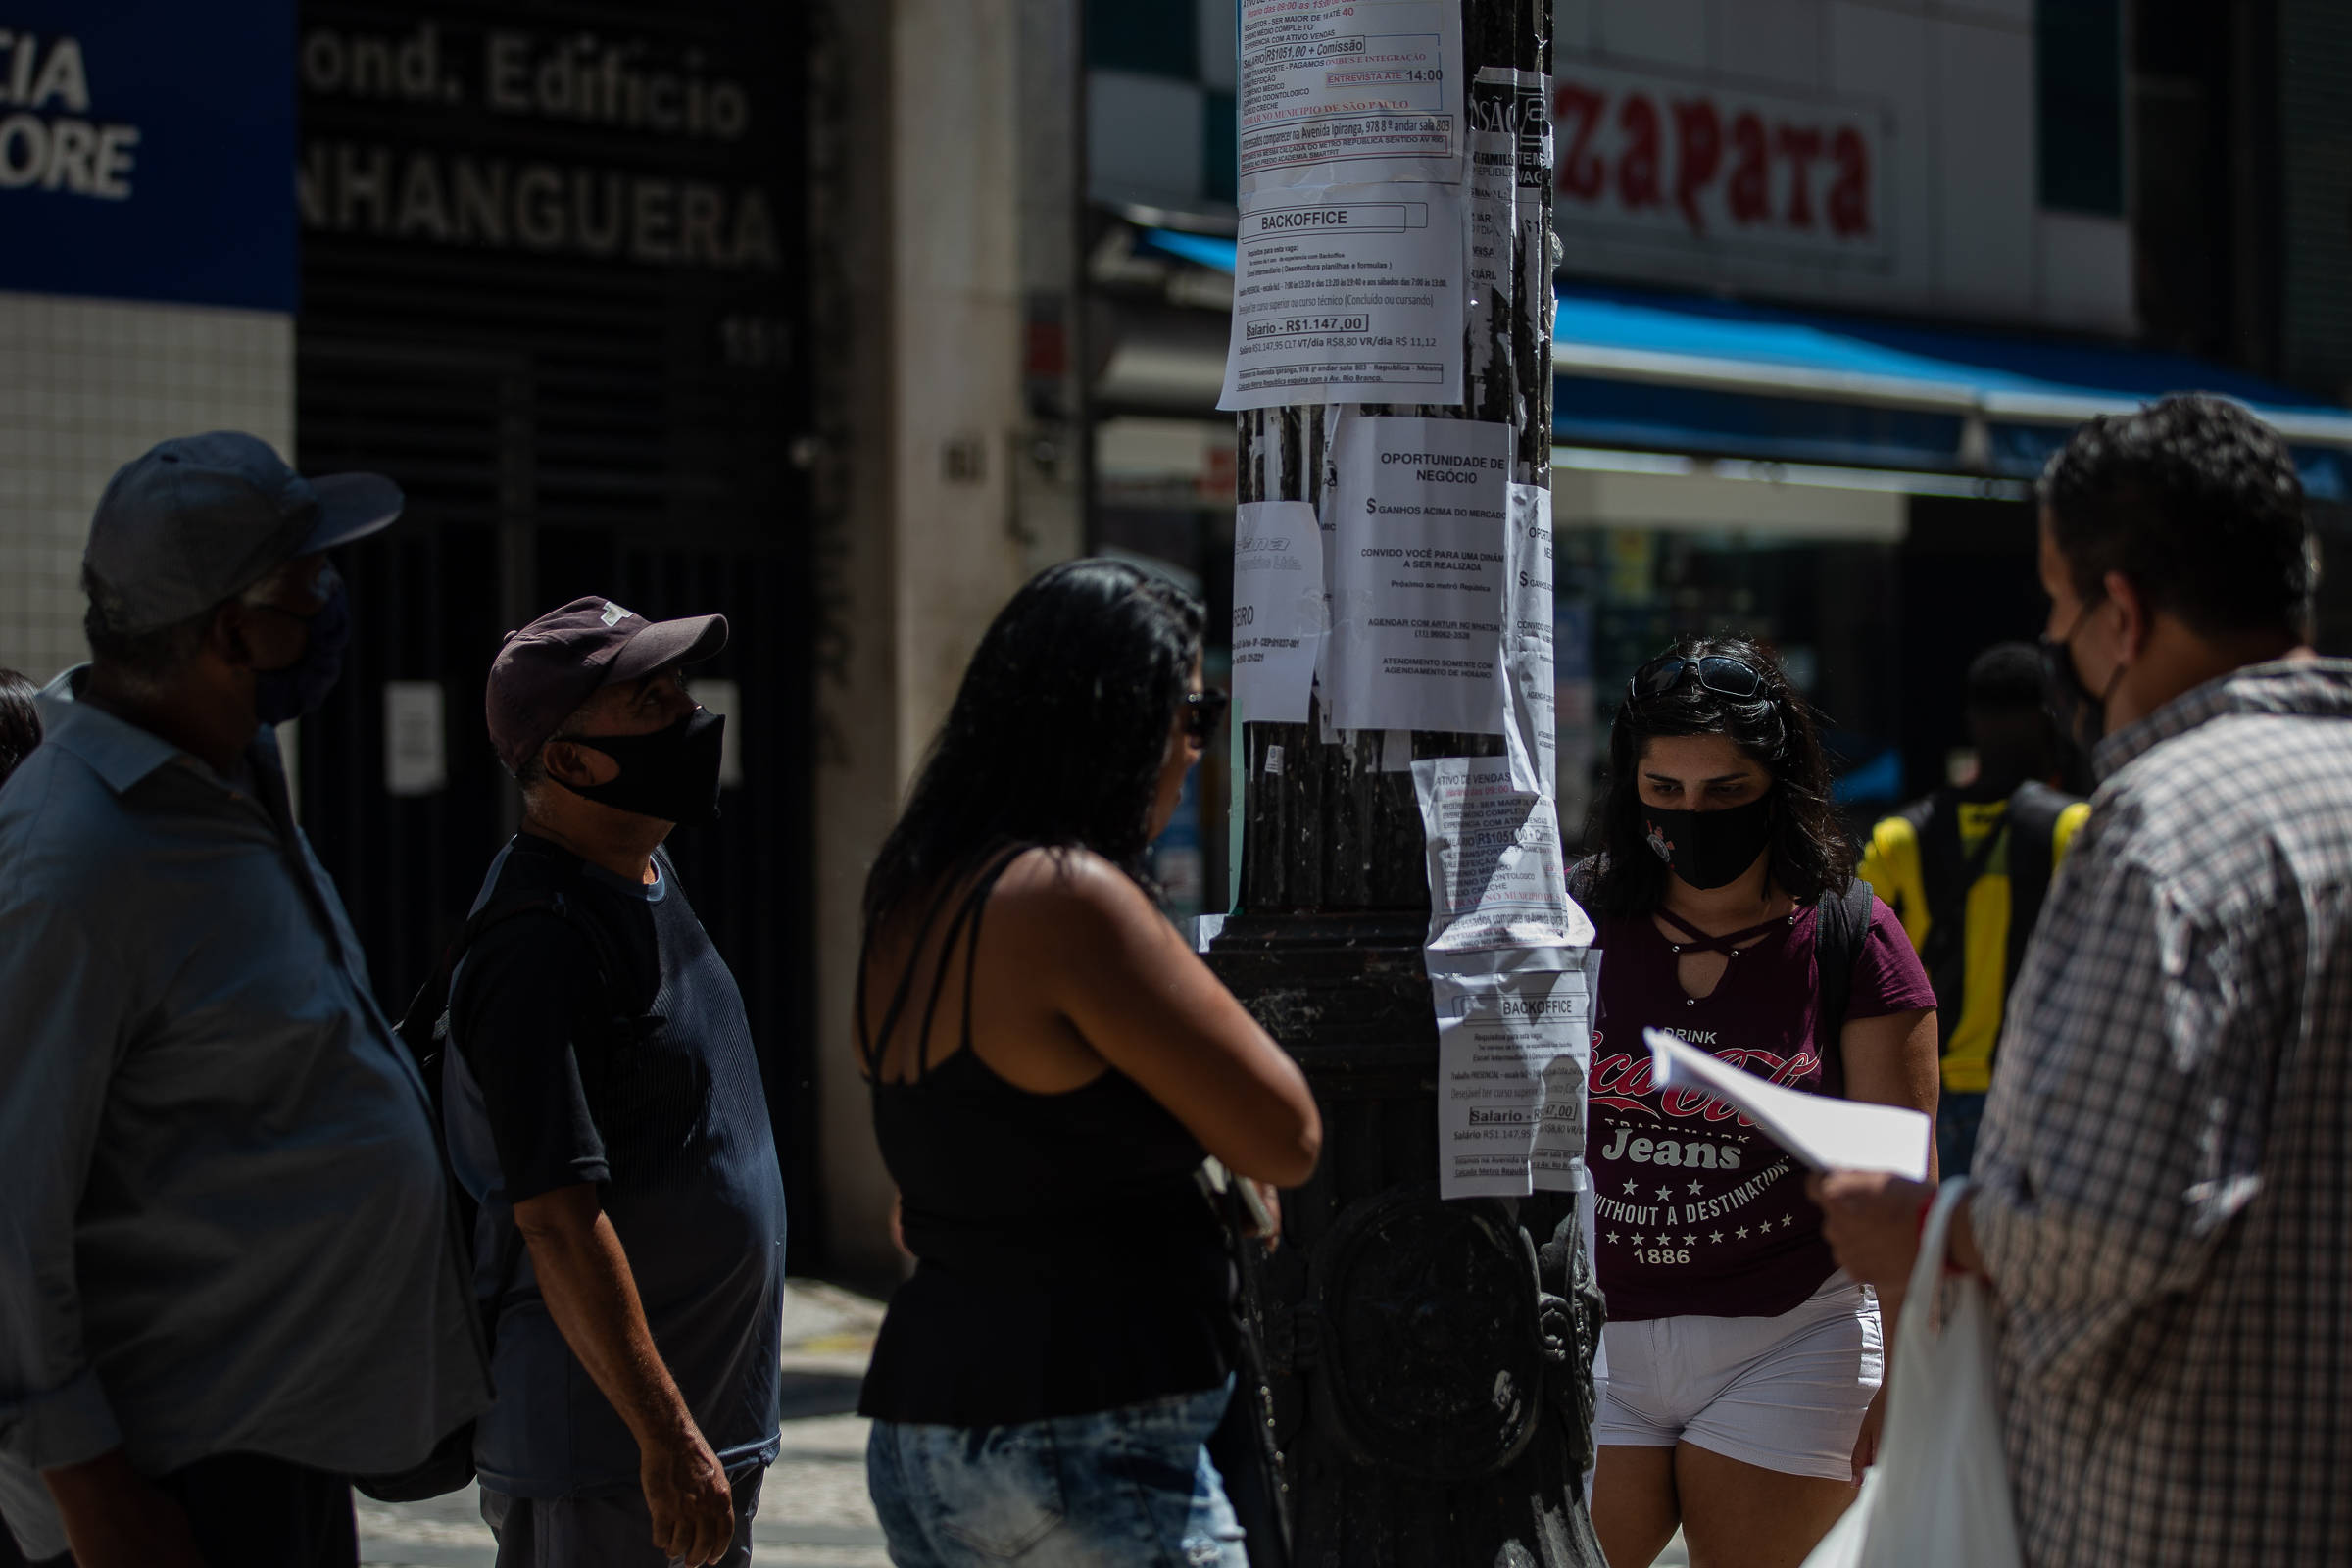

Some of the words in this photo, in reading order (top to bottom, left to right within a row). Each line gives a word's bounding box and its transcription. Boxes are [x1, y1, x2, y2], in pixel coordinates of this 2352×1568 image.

[1274, 24, 1313, 33] COMPLETO
[1289, 60, 1324, 69] PAGAMOS
[1328, 74, 1383, 83] ENTREVISTA
[1406, 70, 1443, 81] 14:00
[1324, 103, 1341, 113] DE
[1343, 101, 1366, 111] SÃO
[1369, 101, 1409, 110] PAULO
[1302, 123, 1330, 138] Avenida
[1366, 120, 1380, 133] 978
[1395, 120, 1417, 131] andar
[1419, 119, 1434, 131] sala
[1309, 148, 1339, 159] SMARTFIT
[1261, 211, 1348, 230] BACKOFFICE
[1318, 295, 1343, 306] técnico
[1384, 296, 1395, 305] ou
[1396, 294, 1434, 308] cursando)
[1247, 322, 1276, 337] Salario
[1326, 336, 1357, 347] R$8,80
[1359, 336, 1393, 347] VR/dia
[1396, 336, 1407, 347] R$
[1411, 337, 1436, 348] 11,12
[1381, 452, 1487, 468] OPORTUNIDADE
[1490, 458, 1504, 469] DE
[1416, 468, 1477, 484] NEGÓCIO
[1379, 506, 1421, 514] GANHOS
[1423, 506, 1450, 515] ACIMA
[1454, 508, 1468, 516] DO
[1406, 547, 1432, 558] VOCÊ
[1435, 549, 1458, 560] PARA
[1461, 551, 1478, 561] UMA
[1412, 561, 1431, 569] SER
[1434, 562, 1482, 571] REALIZADA
[1368, 618, 1408, 627] AGENDAR
[1383, 658, 1440, 667] ATENDIMENTO
[1472, 772, 1511, 785] VENDAS
[1502, 1000, 1572, 1015] BACKOFFICE
[1471, 1109, 1522, 1122] Salario
[1602, 1129, 1741, 1169] Jeans
[1667, 1211, 1679, 1226] A
[1634, 1249, 1690, 1264] 1886
